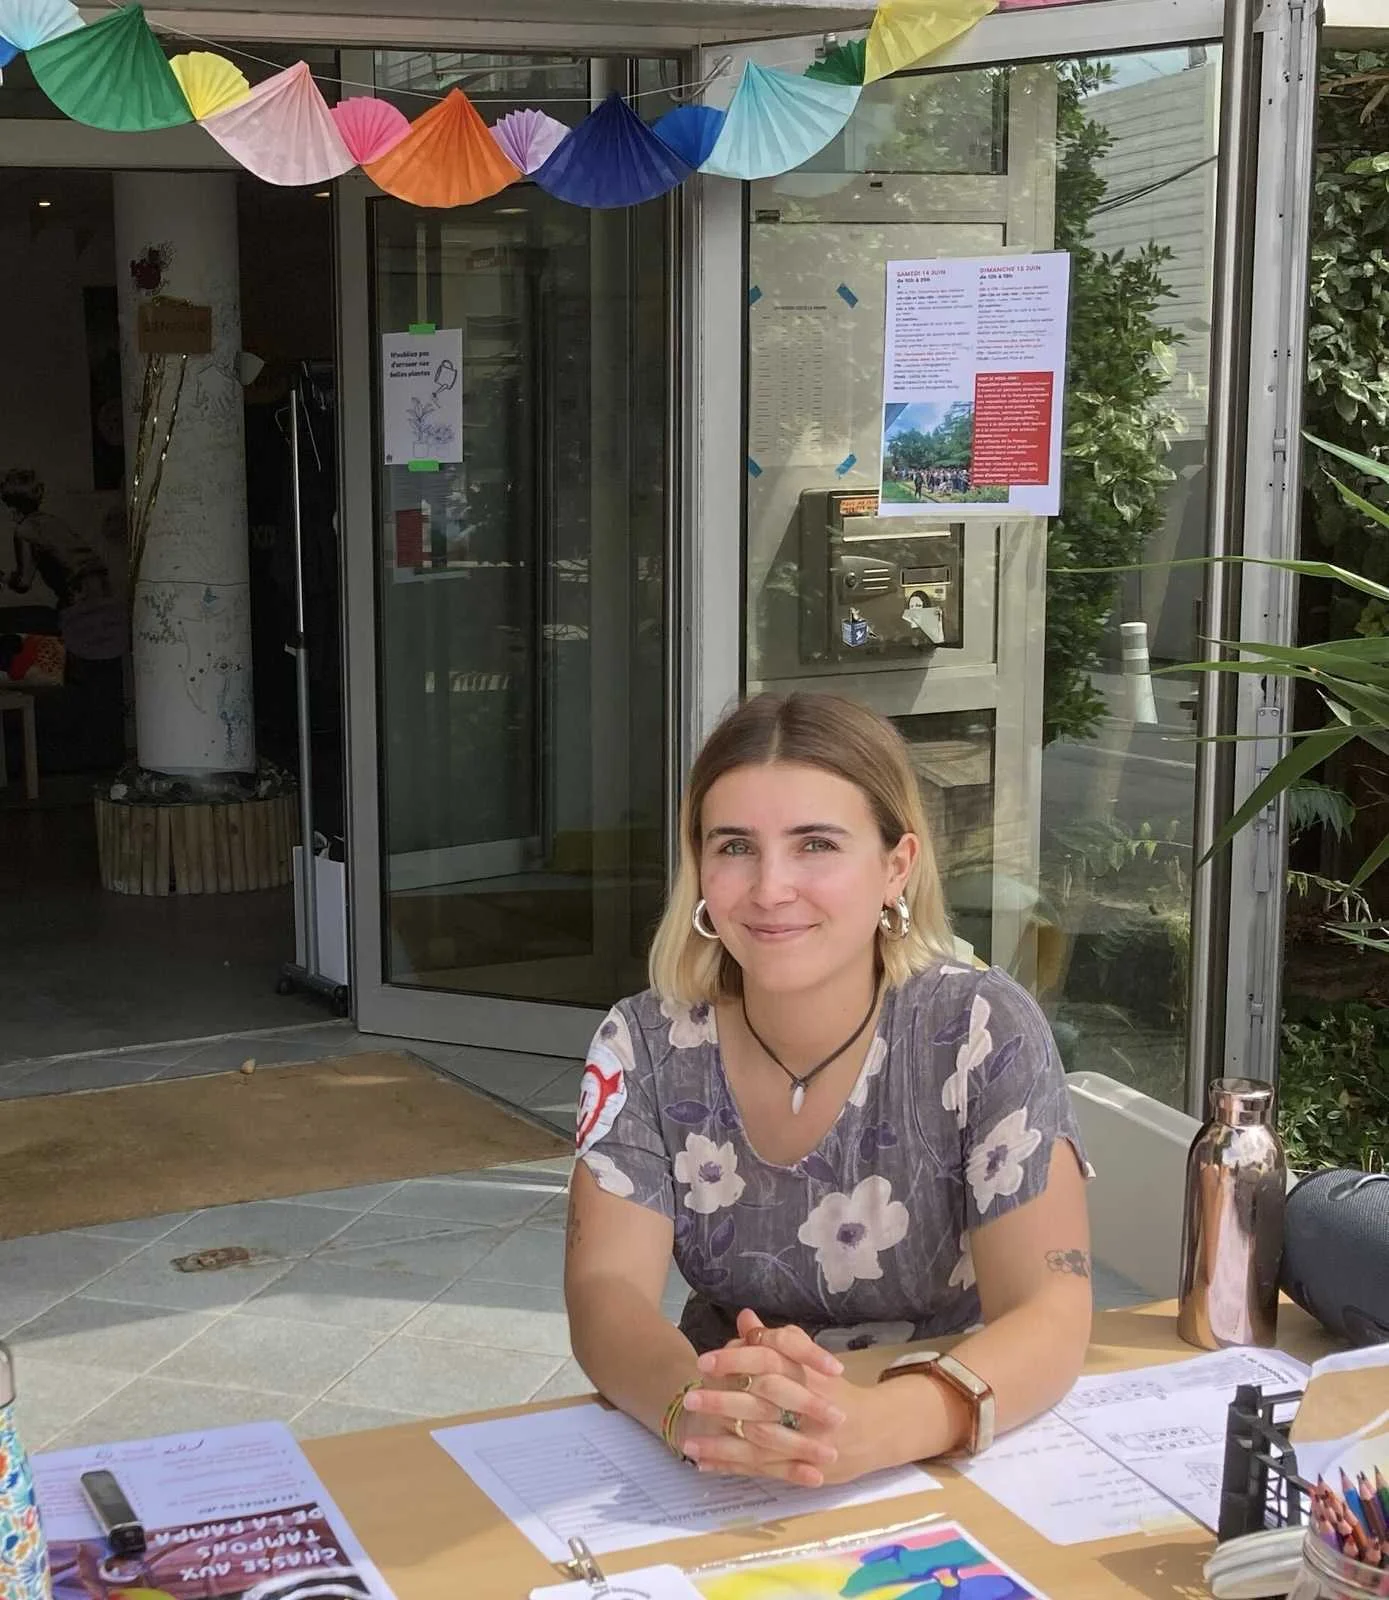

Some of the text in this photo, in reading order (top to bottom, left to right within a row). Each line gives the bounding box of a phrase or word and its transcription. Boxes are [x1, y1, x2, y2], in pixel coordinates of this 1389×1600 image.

[154, 1506, 324, 1546] DE LA PAMPA
[196, 1528, 320, 1558] TAMPONS
[178, 1547, 338, 1582] CHASSE AUX
